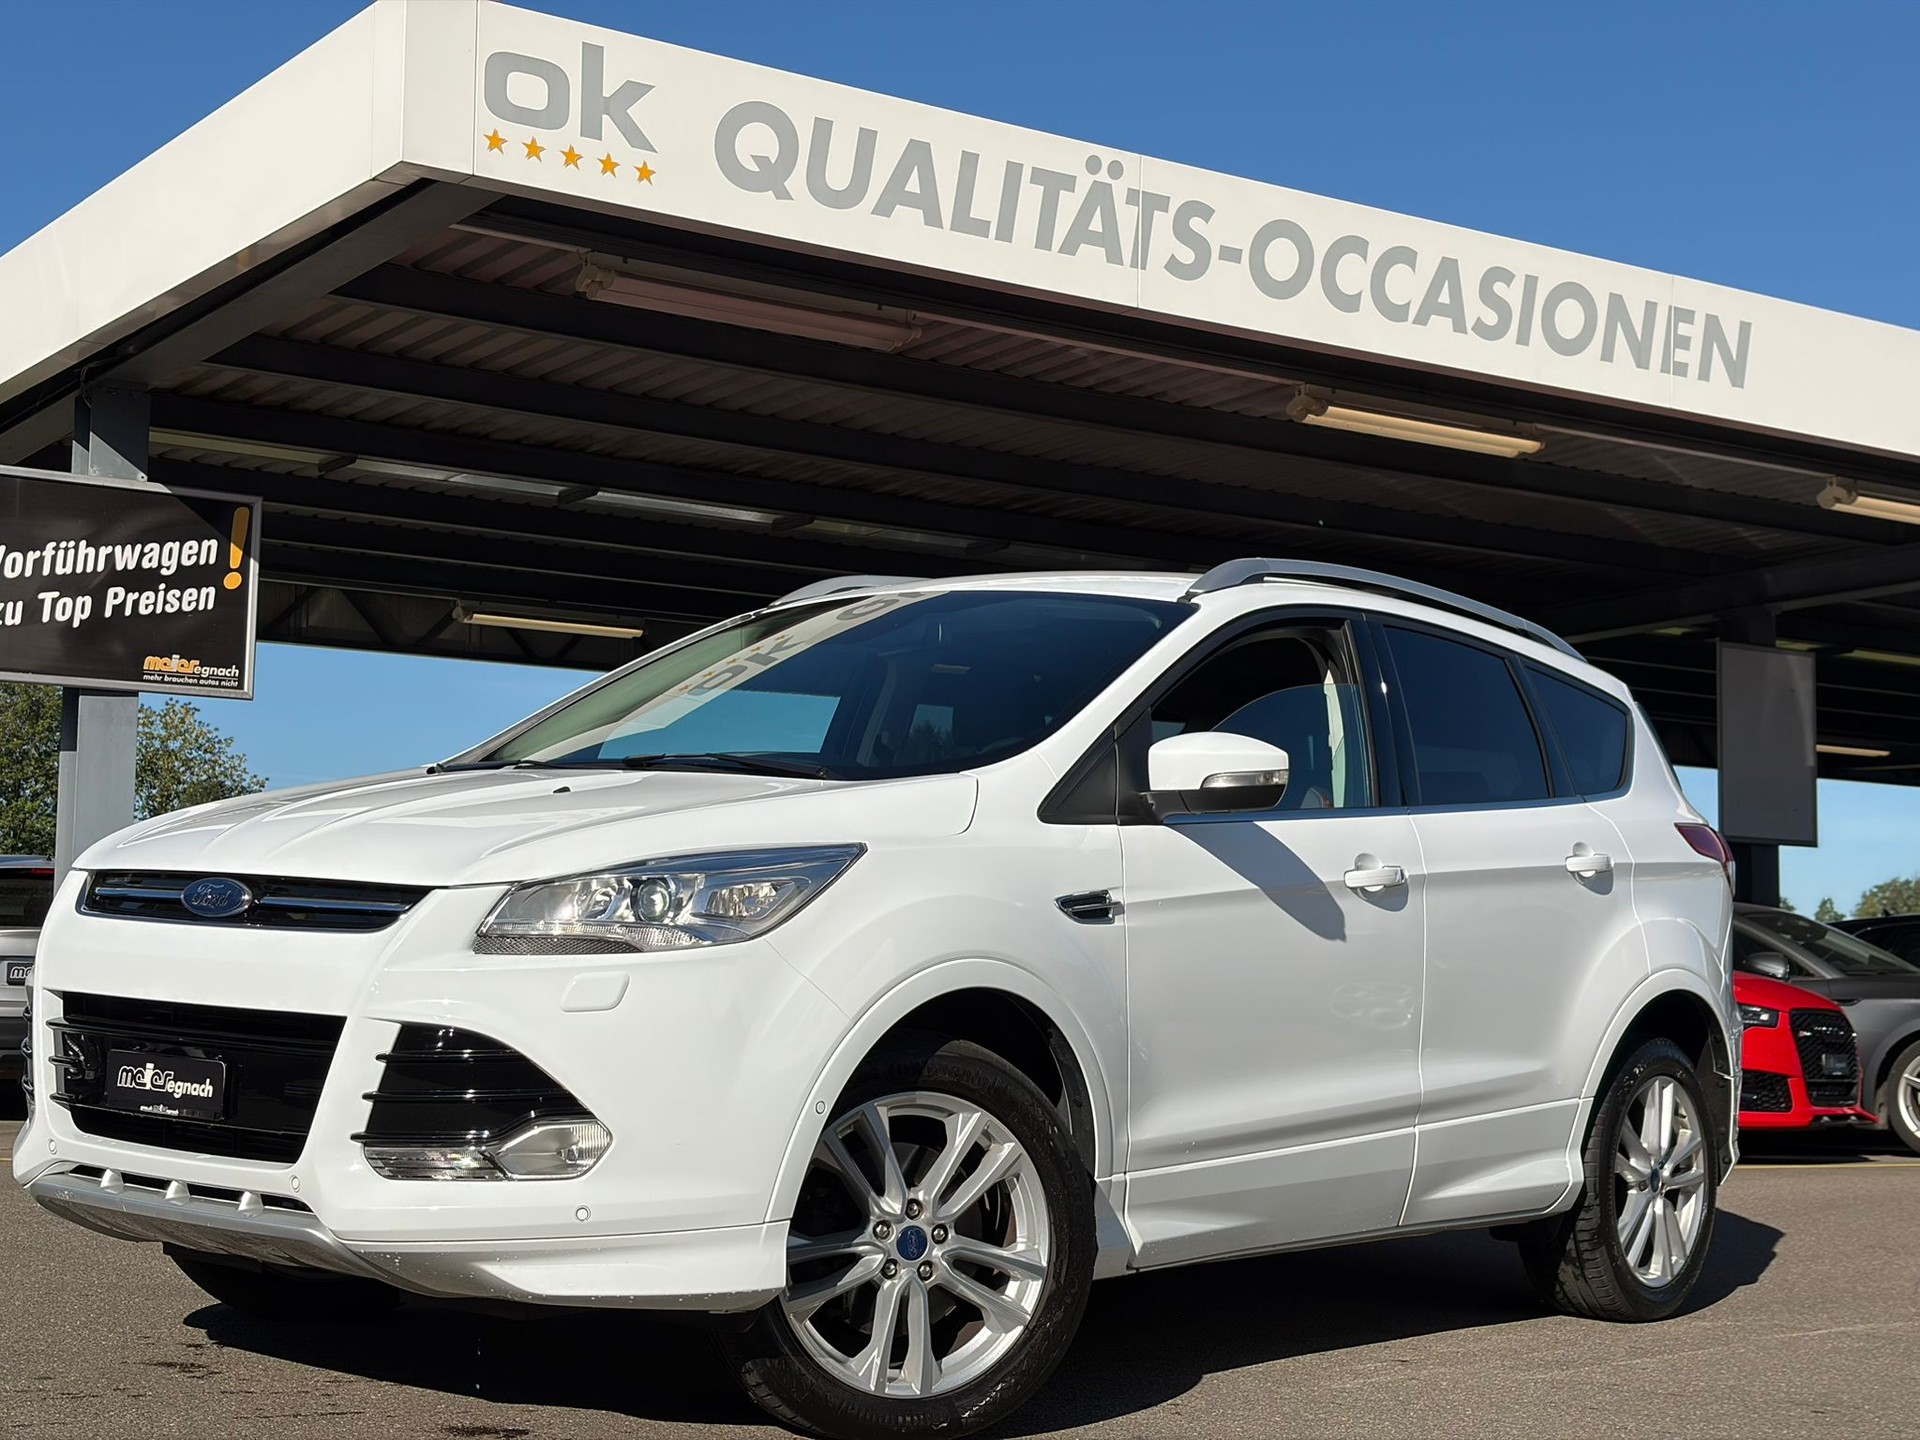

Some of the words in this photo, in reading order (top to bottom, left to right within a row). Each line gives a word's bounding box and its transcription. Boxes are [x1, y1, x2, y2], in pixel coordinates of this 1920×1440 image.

[483, 40, 658, 153] ok
[714, 100, 1752, 389] QUALITÄTS-OCCASIONEN
[37, 591, 92, 629] Top
[104, 583, 216, 618] Preisen
[143, 673, 162, 682] mehr
[164, 675, 198, 684] brauchen
[220, 679, 239, 687] nicht
